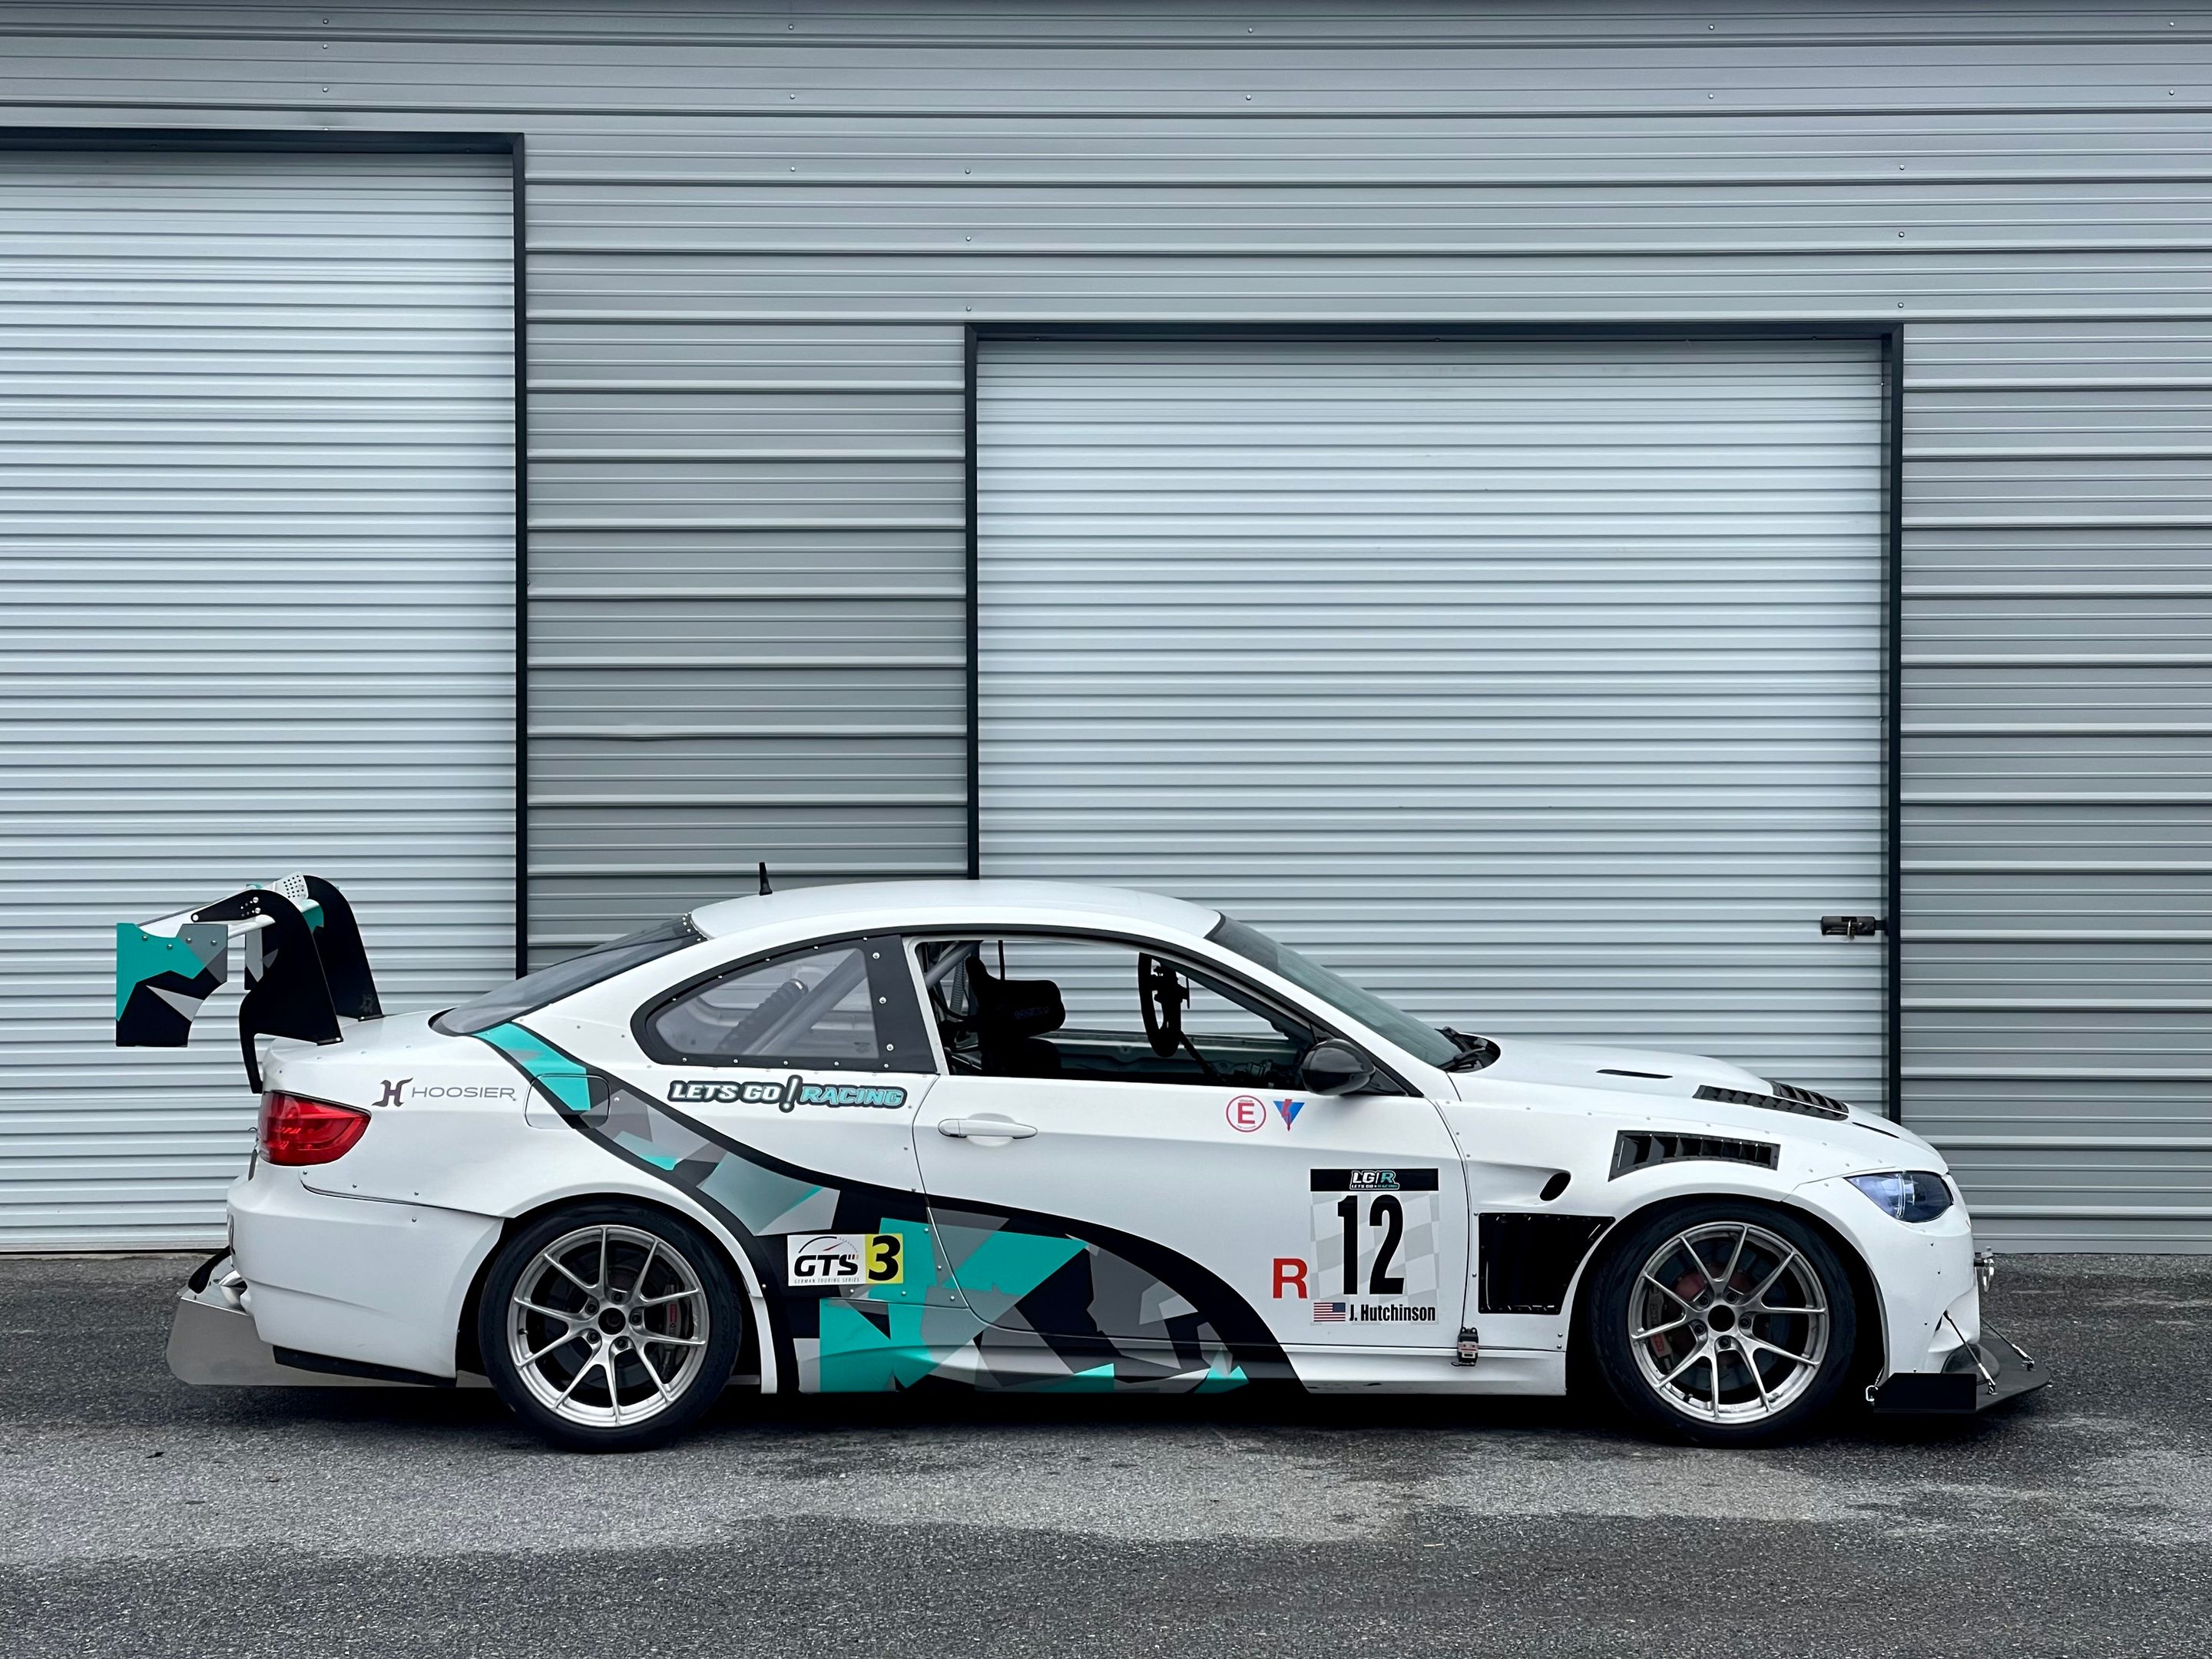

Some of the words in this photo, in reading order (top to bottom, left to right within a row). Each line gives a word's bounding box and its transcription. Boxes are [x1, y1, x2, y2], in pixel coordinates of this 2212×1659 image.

[412, 1087, 515, 1100] HOOSIER
[671, 1083, 740, 1100] LETS
[800, 1085, 905, 1106] RACING
[1237, 1102, 1255, 1124] E
[1337, 1194, 1405, 1295] 12
[794, 1254, 859, 1277] GTS
[868, 1235, 901, 1281] 3
[1273, 1258, 1308, 1299] R
[1349, 1304, 1358, 1321] J.
[1360, 1304, 1435, 1321] Hutchinson
